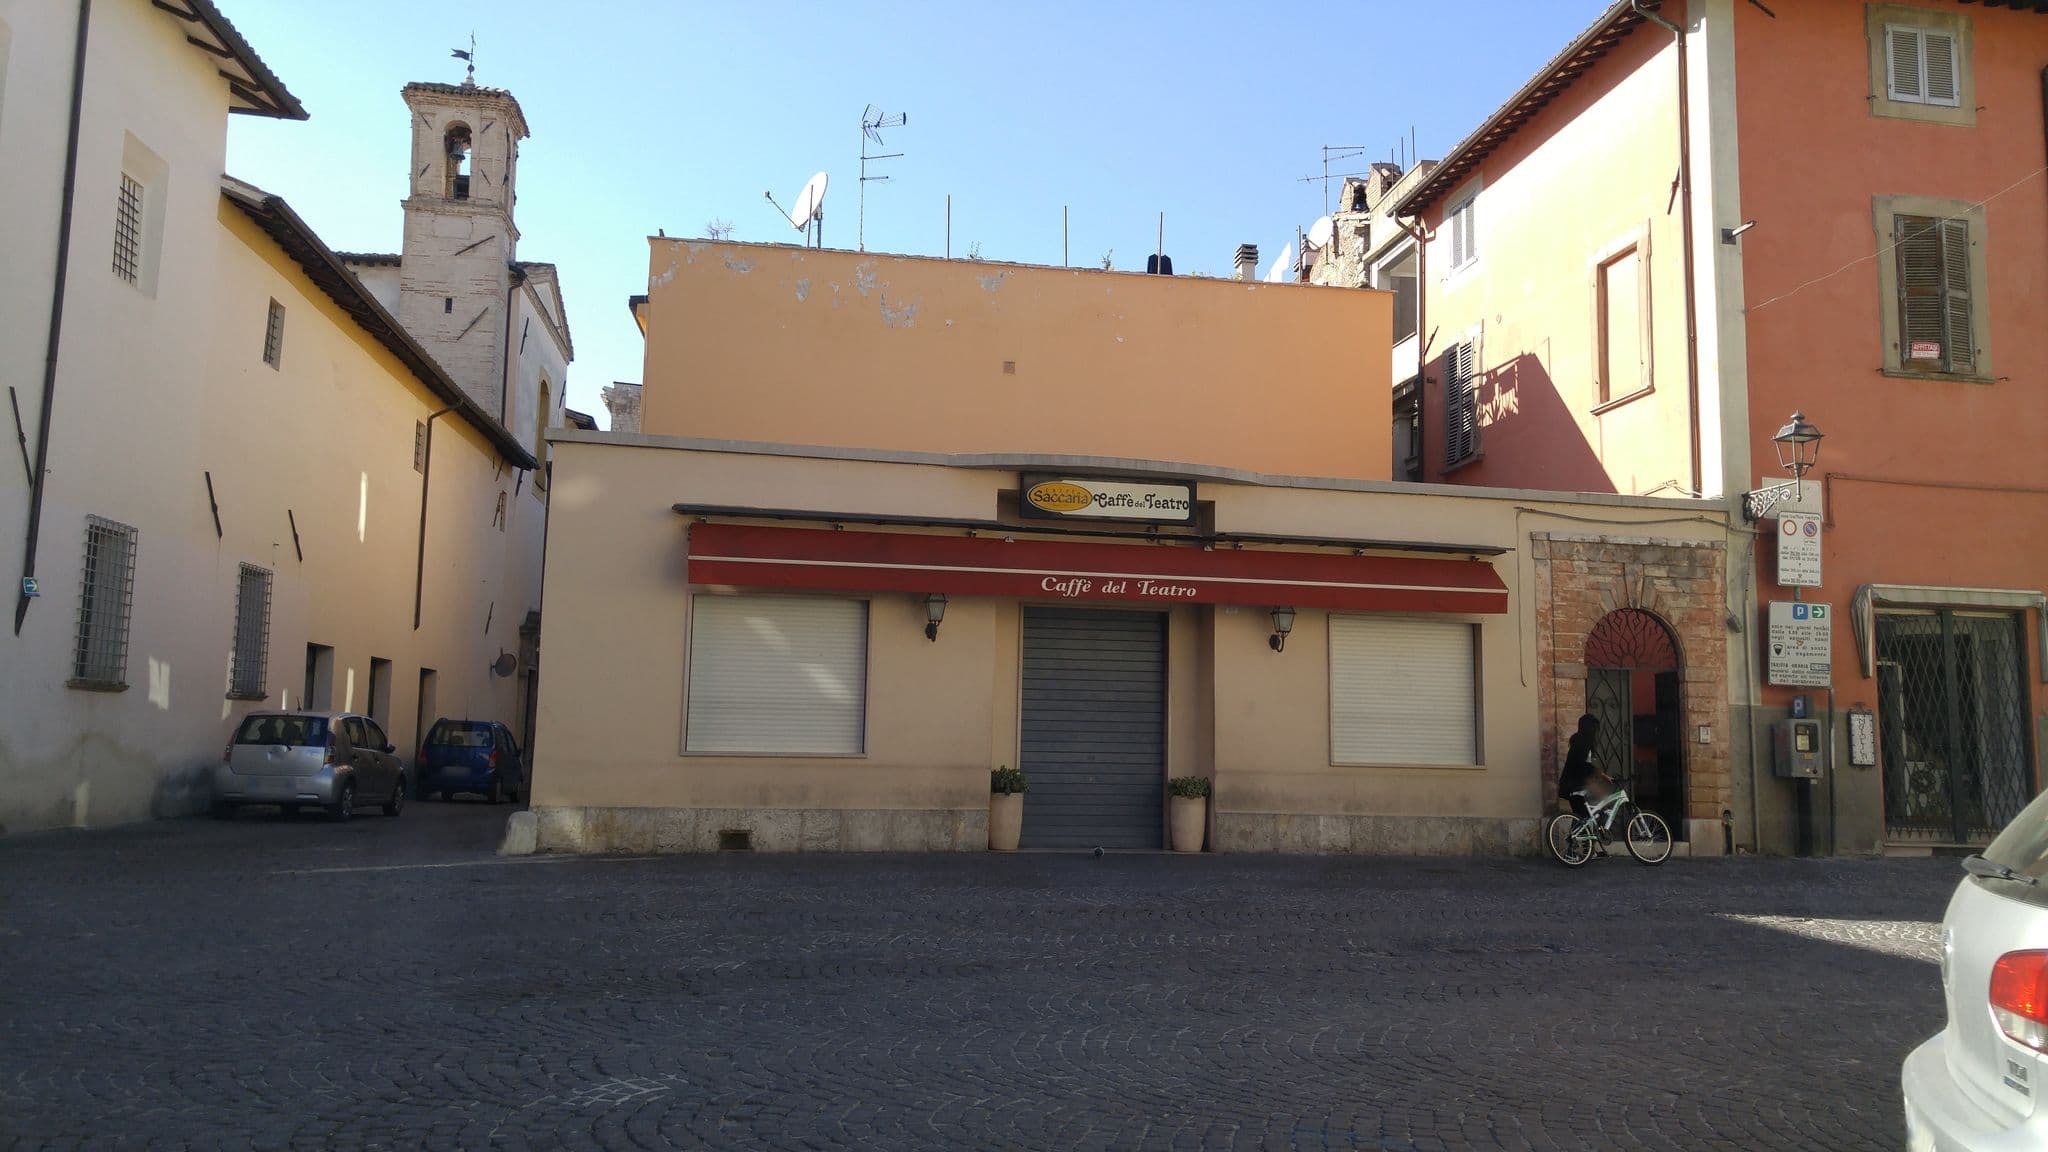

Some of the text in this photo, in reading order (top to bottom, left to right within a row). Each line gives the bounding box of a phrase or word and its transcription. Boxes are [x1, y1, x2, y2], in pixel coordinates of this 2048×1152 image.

[1034, 490, 1088, 504] Saccaria
[1094, 492, 1188, 510] Caffè del Teatro
[1041, 576, 1197, 597] Caffè del Teatro
